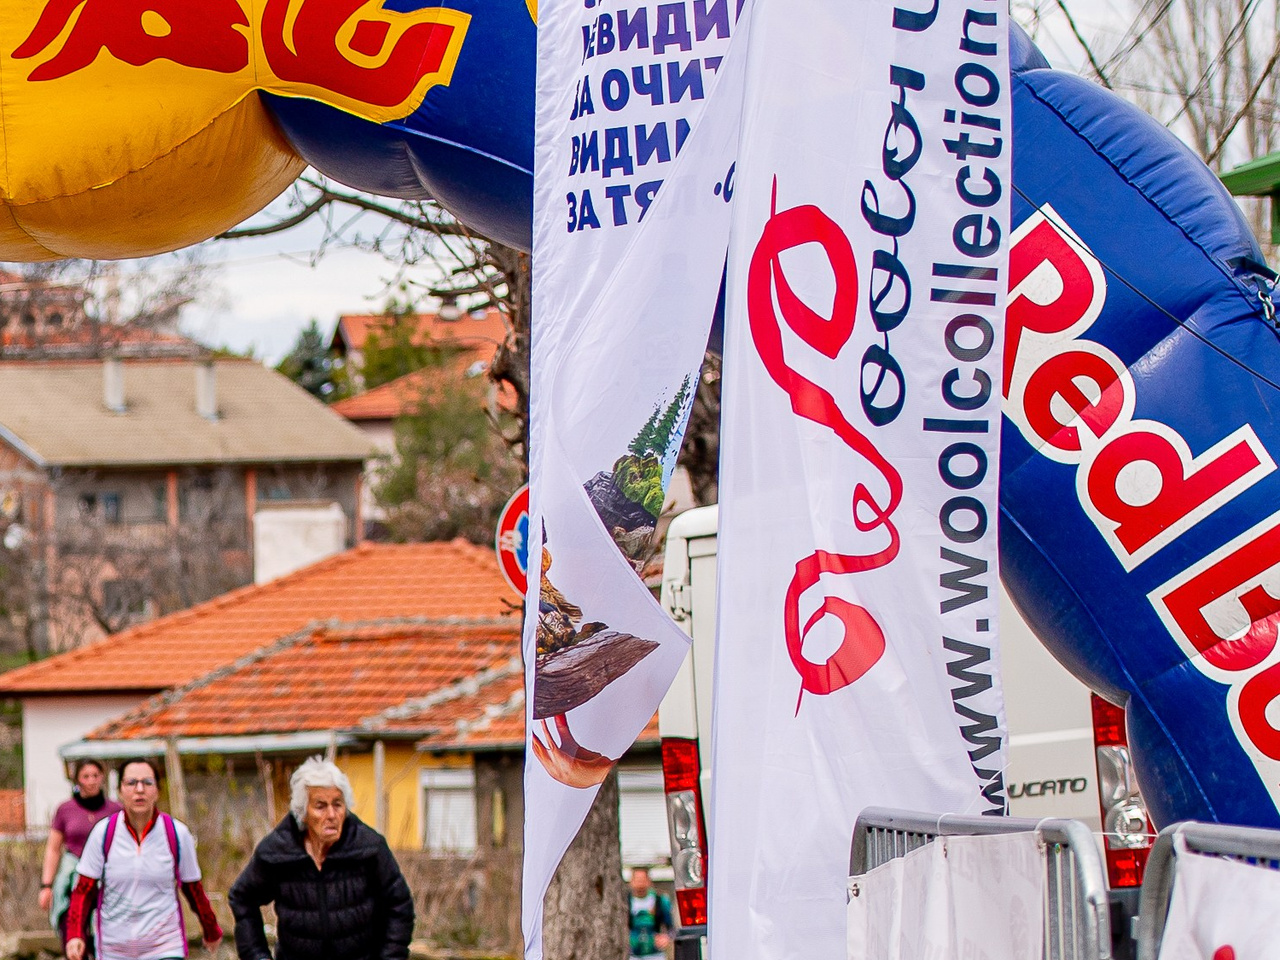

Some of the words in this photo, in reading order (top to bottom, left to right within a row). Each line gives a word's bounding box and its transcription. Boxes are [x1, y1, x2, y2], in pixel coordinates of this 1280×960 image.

[566, 189, 601, 234] ЗА
[998, 208, 1268, 564] Red
[1007, 777, 1088, 799] UCATO
